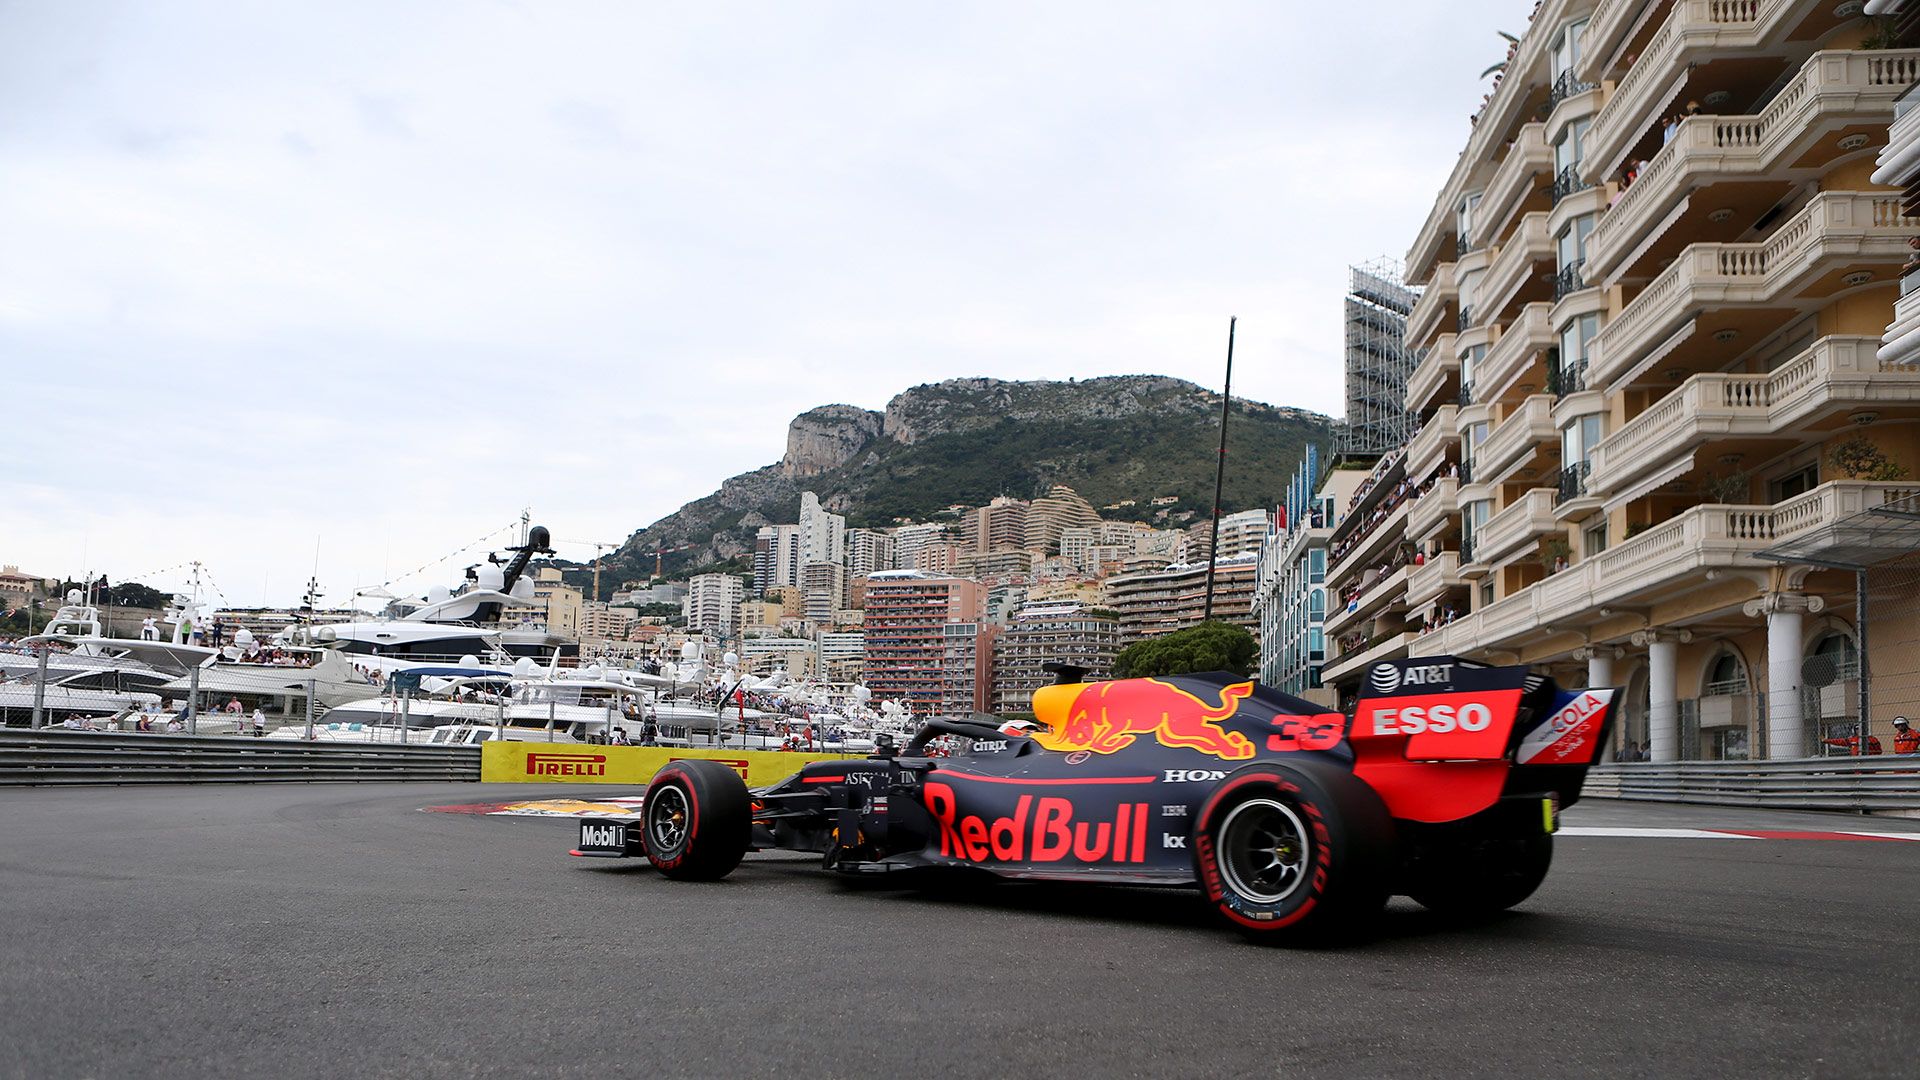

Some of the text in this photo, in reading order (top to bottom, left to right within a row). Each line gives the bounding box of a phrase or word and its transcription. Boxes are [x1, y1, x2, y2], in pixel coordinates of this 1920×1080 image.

[1403, 663, 1454, 686] AT&T
[1373, 703, 1492, 736] ESSO
[1551, 694, 1602, 733] COLA
[1266, 713, 1346, 752] 33
[527, 753, 607, 776] PIRELLI
[1162, 769, 1232, 783] HON
[1162, 805, 1187, 816] IBM
[582, 825, 616, 846] Mobil
